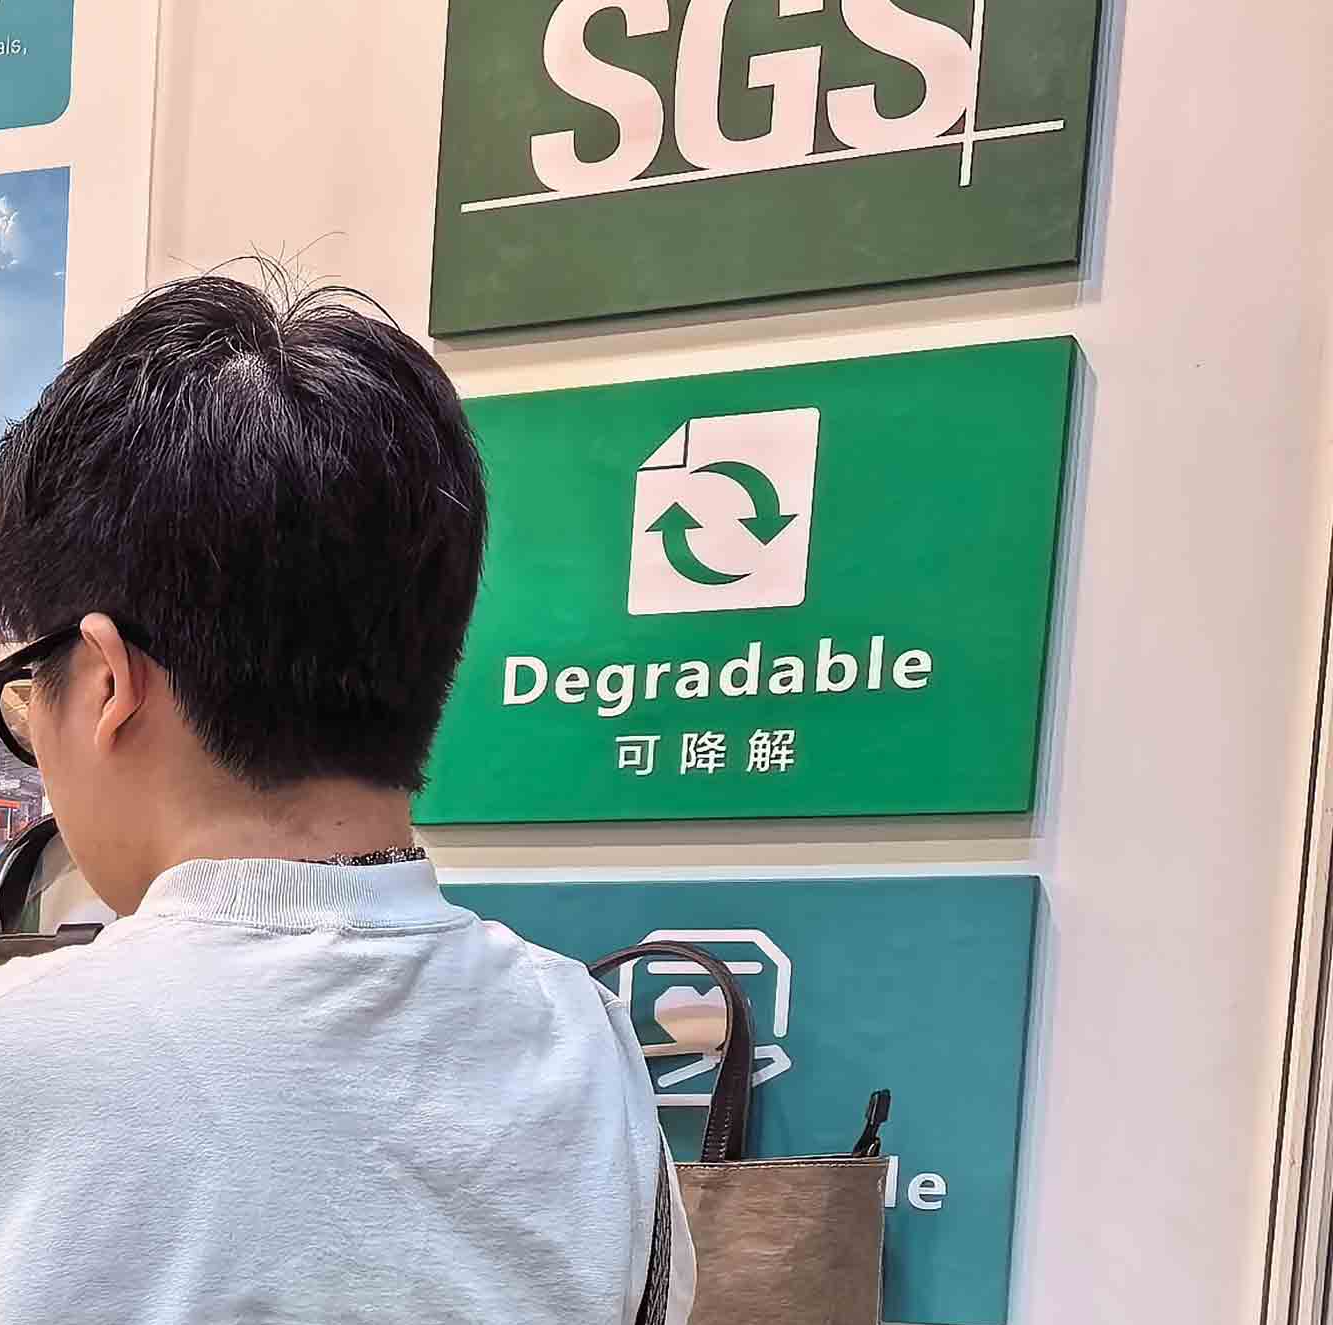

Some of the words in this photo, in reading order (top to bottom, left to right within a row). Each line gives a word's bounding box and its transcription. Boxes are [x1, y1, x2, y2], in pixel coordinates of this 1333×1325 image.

[531, 0, 975, 193] SGS
[502, 635, 934, 717] Degradable
[615, 730, 797, 776] 可降解
